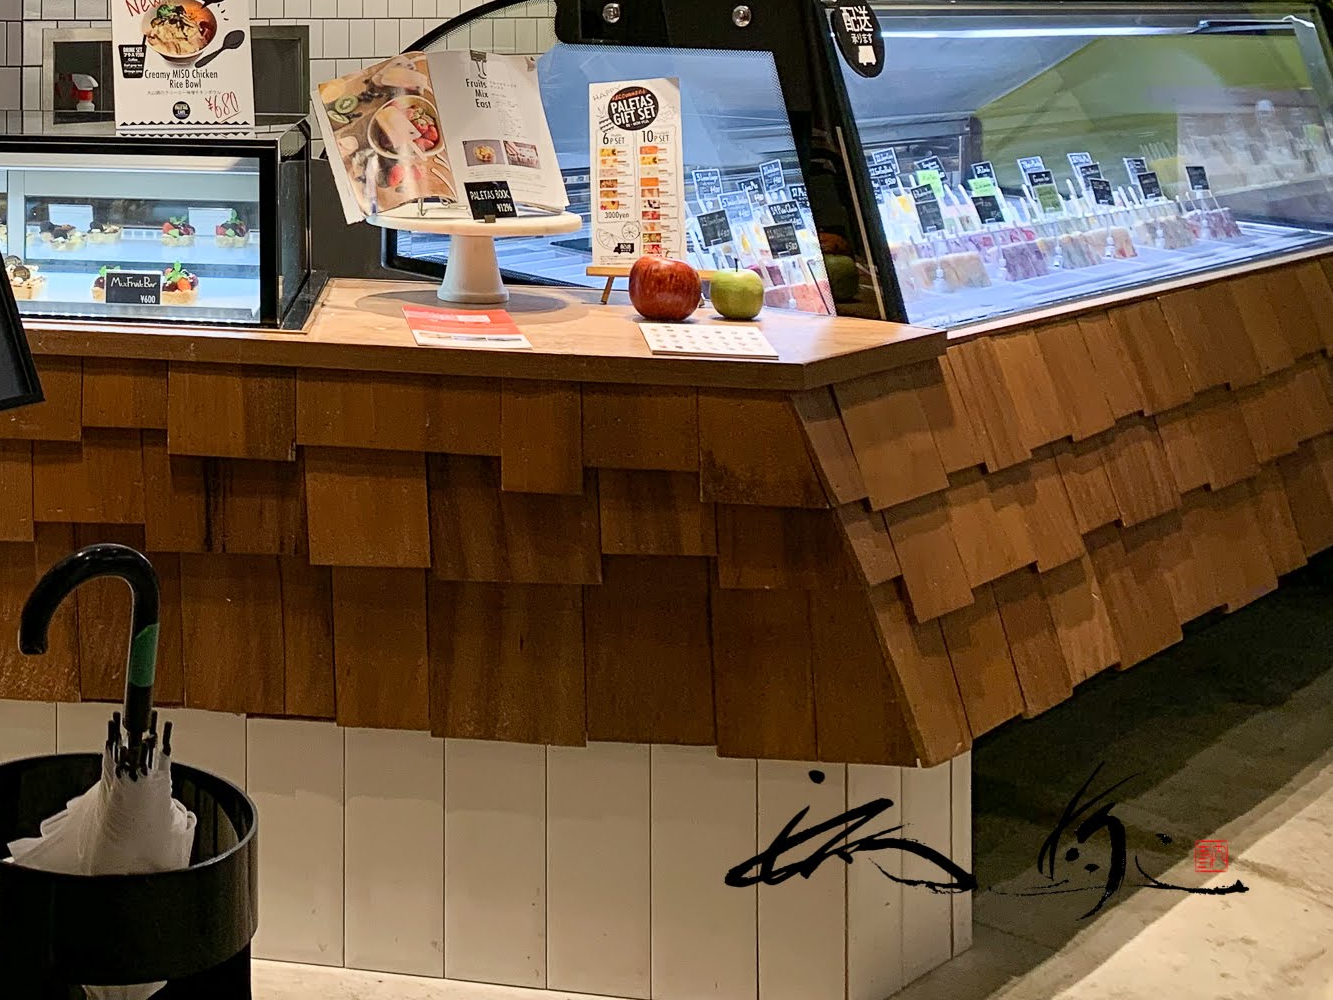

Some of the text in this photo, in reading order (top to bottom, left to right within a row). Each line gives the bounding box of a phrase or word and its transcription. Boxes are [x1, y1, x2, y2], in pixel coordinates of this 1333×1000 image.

[839, 5, 874, 33] 配送
[145, 69, 218, 81] Creamy MISO Chicken
[169, 79, 202, 89] Rice Bowl
[465, 78, 488, 89] Fruits
[474, 88, 489, 98] Mix
[475, 98, 492, 109] East
[610, 93, 654, 114] PALETAS
[613, 109, 637, 126] GIFT
[637, 105, 656, 121] SET
[469, 189, 511, 201] PALETAS BOOK
[140, 294, 156, 304] ¥600
